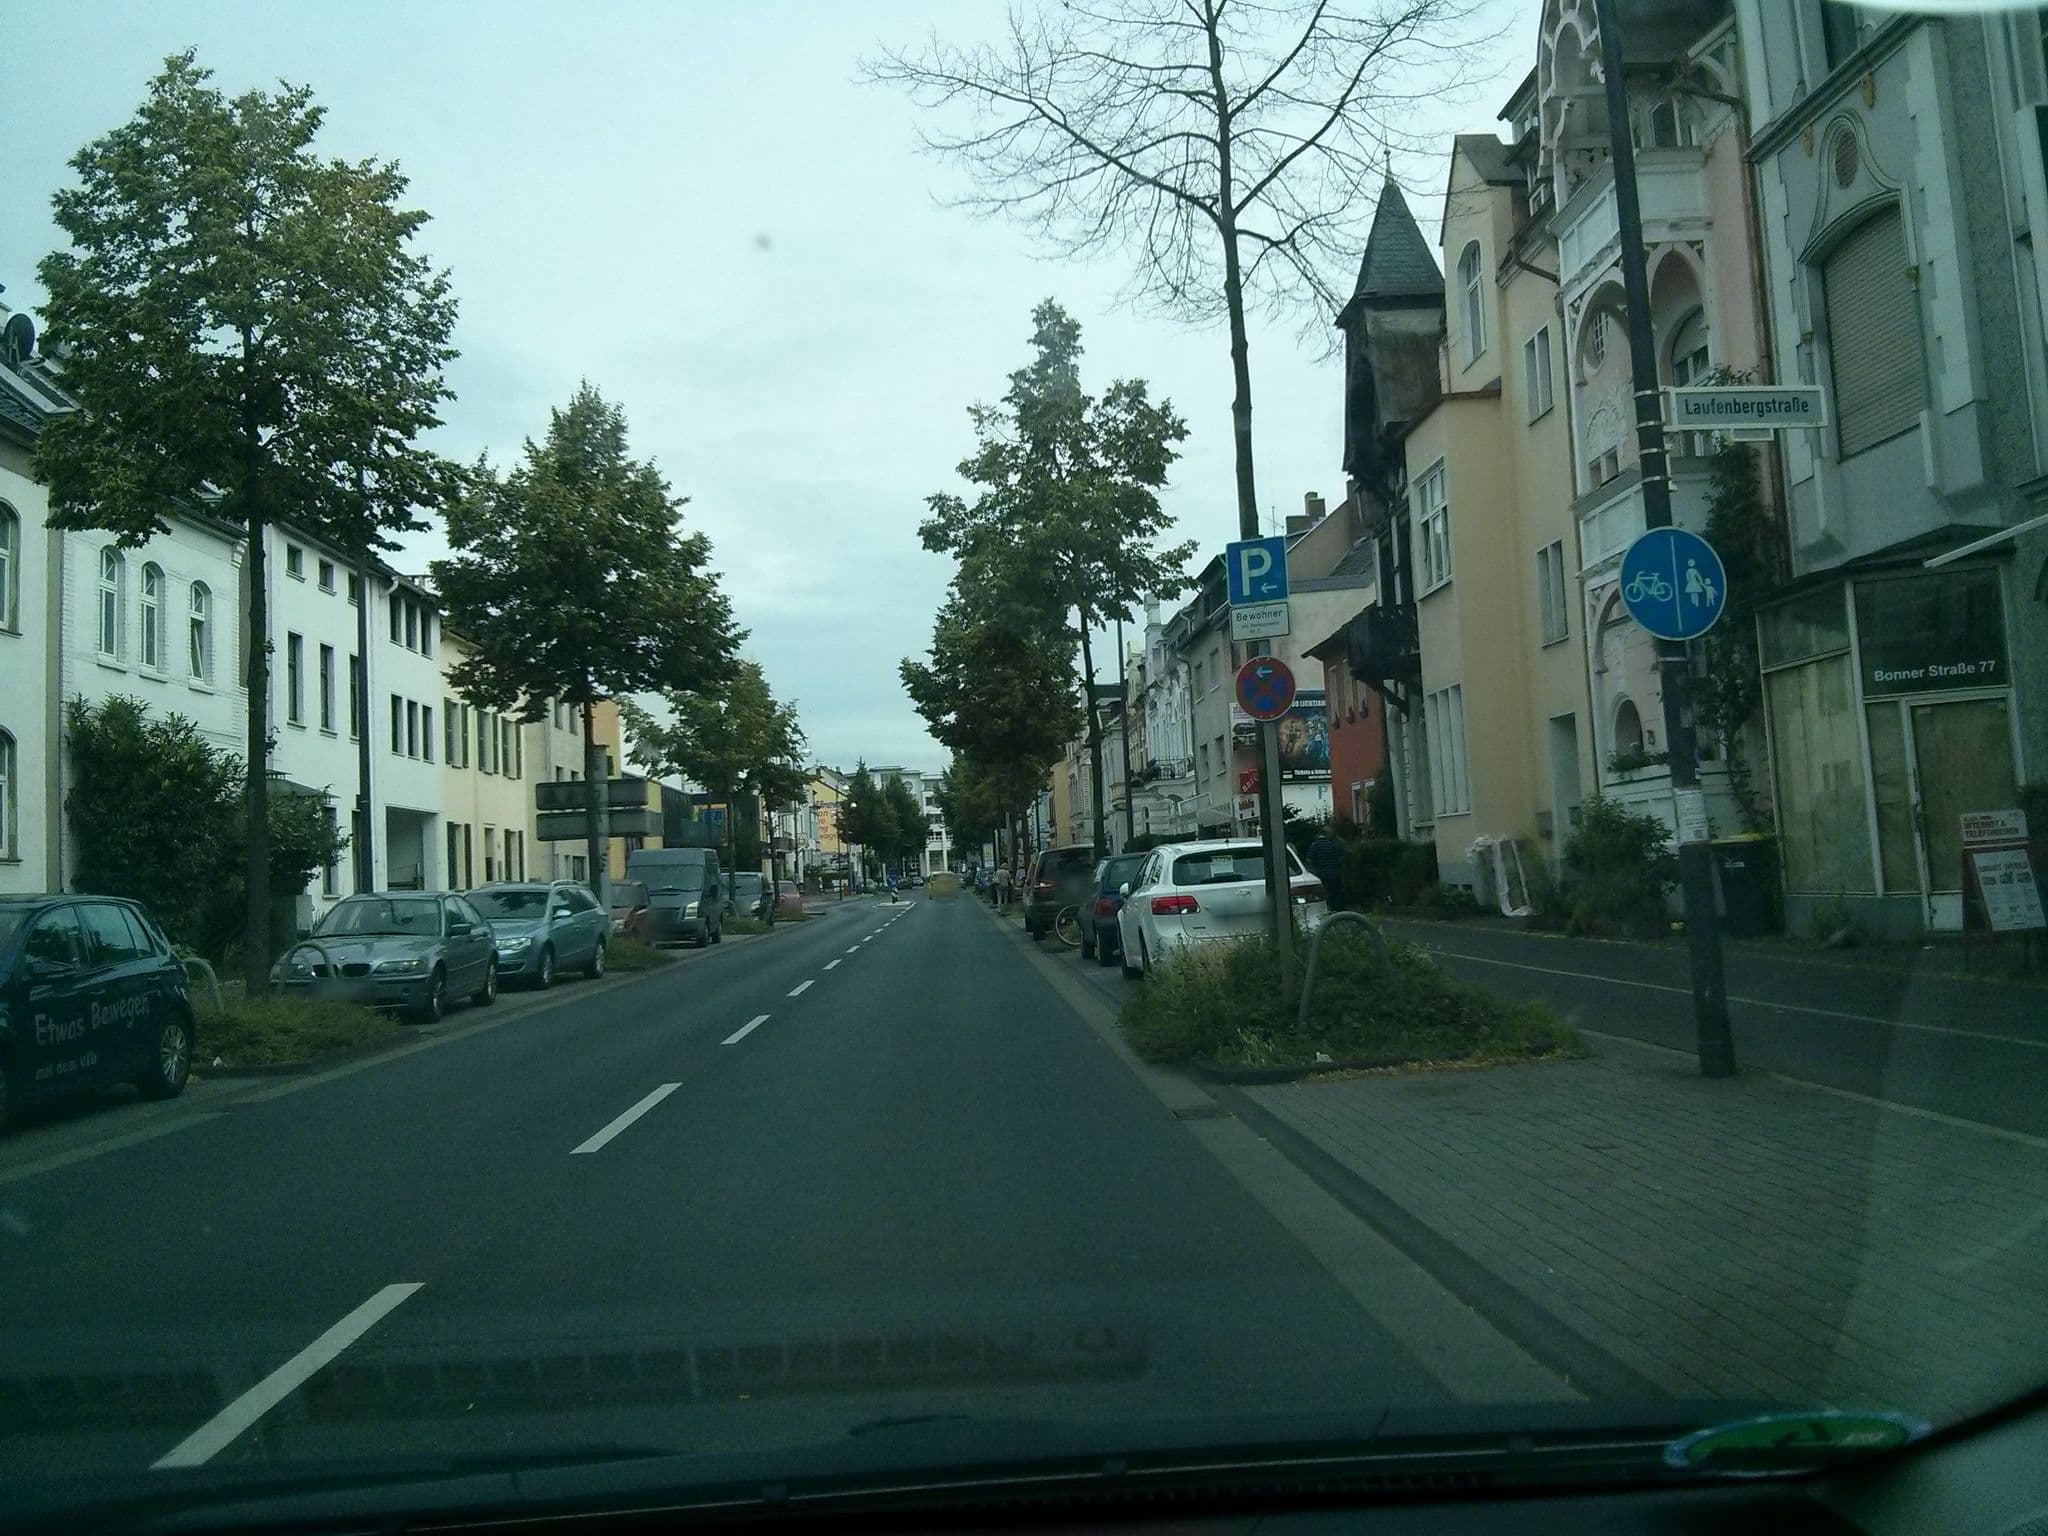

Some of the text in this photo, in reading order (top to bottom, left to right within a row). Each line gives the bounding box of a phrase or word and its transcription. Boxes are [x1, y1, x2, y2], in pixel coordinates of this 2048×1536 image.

[1685, 397, 1809, 417] Laufenbergstraße
[1240, 548, 1272, 596] P
[1236, 609, 1283, 622] Bewohner
[1874, 660, 1996, 682] Bonner Straße 77
[35, 997, 150, 1046] Etwas Bewegen
